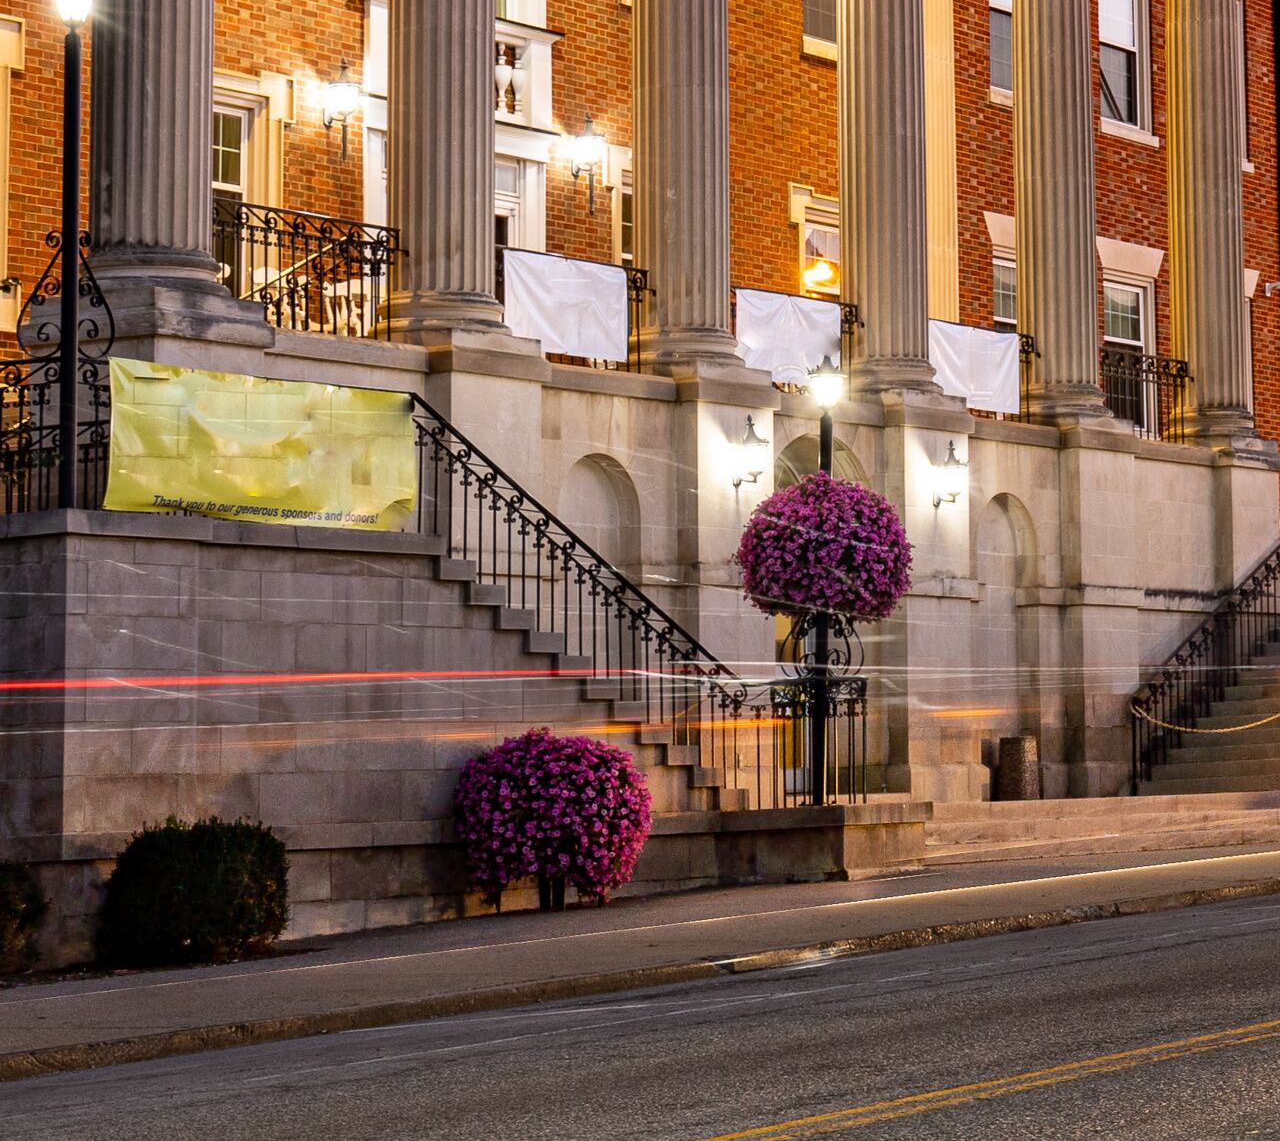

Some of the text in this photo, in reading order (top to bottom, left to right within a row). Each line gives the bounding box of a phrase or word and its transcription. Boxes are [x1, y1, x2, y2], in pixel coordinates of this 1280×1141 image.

[153, 495, 379, 524] Thank you to our generous sponsors and donors!
